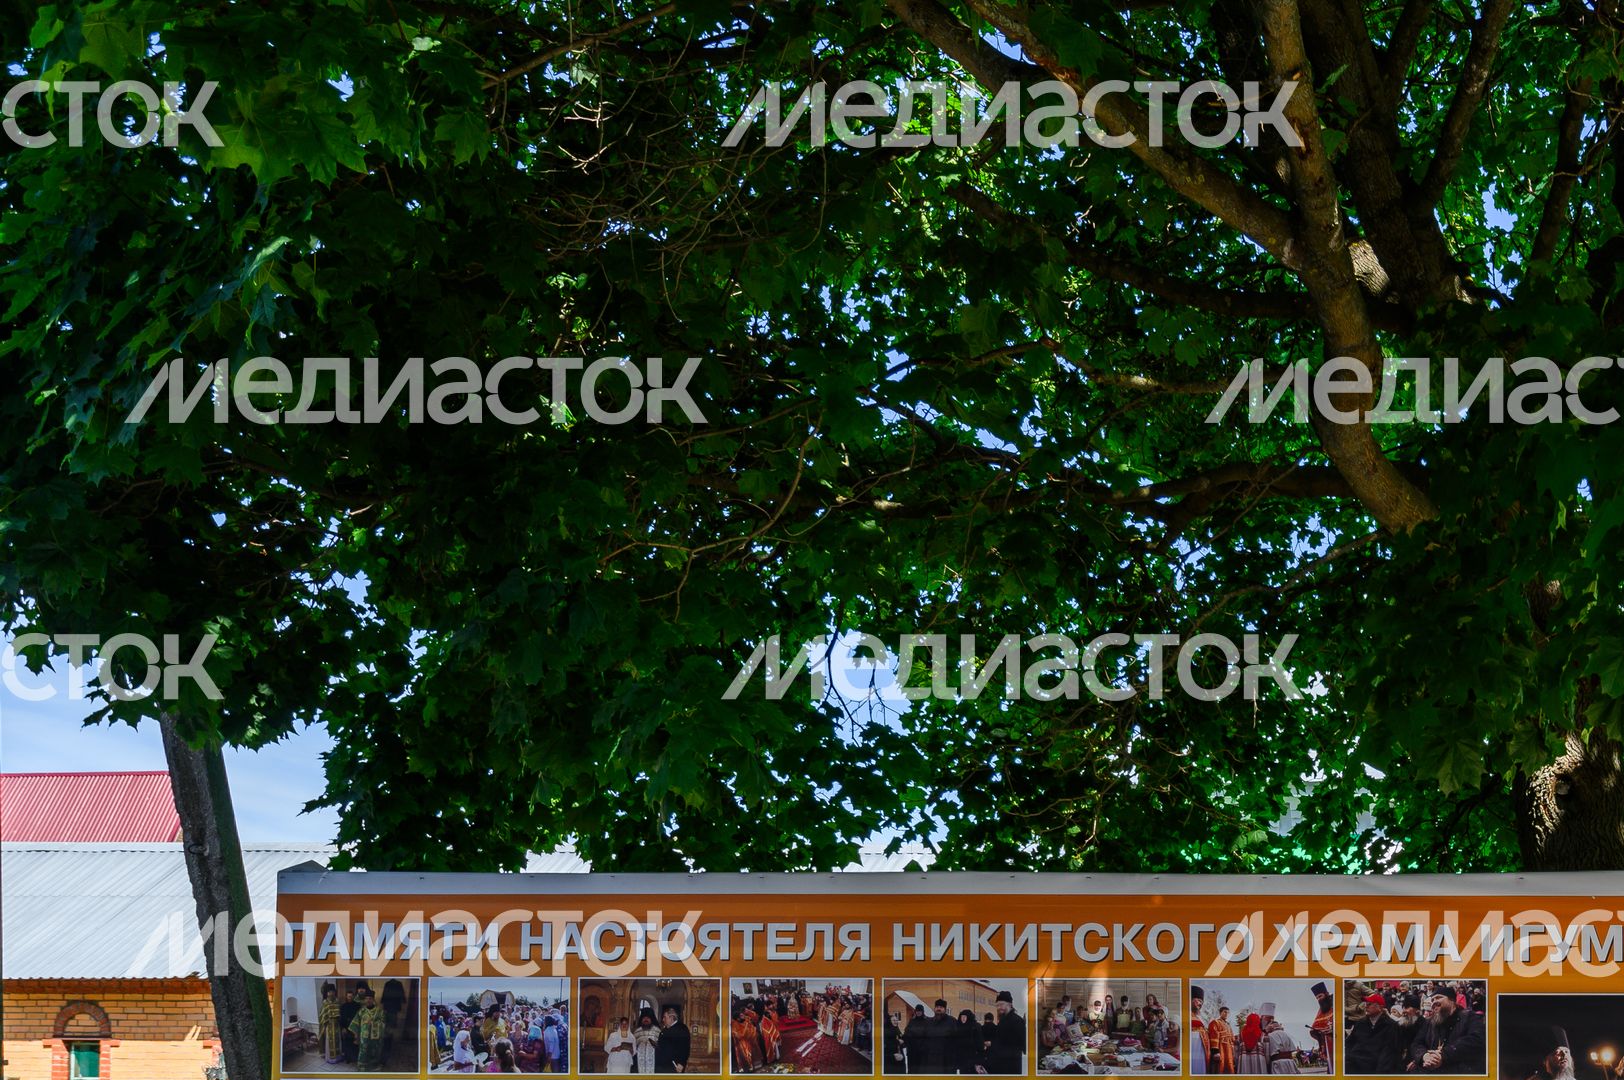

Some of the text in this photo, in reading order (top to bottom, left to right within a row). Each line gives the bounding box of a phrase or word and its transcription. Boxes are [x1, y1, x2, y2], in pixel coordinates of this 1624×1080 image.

[284, 922, 499, 961] ПАМЯТИ
[520, 922, 871, 962] НАСТОЯТЕЛЯ
[892, 922, 1255, 963] НИКИТСКОГО
[1273, 923, 1463, 963] ХРАМА
